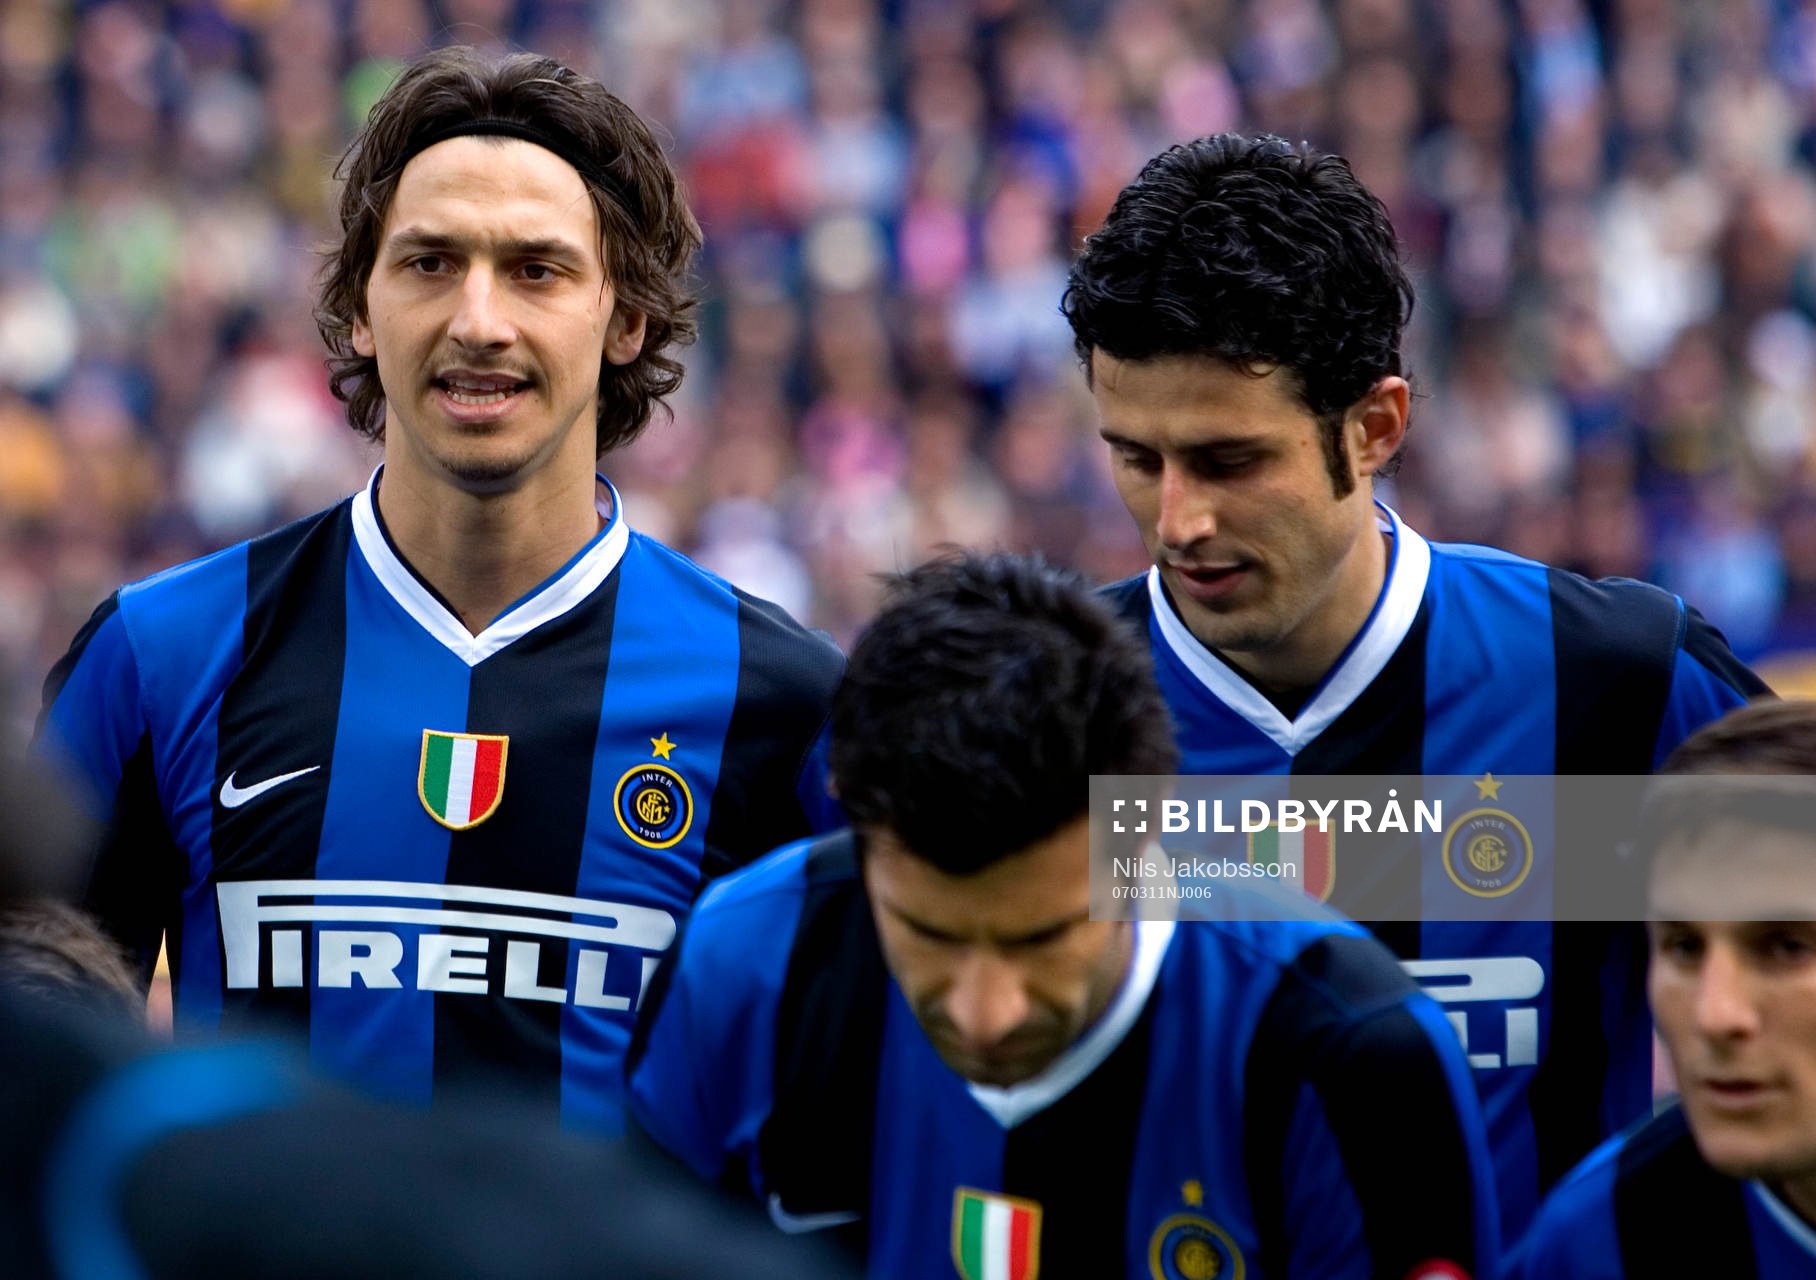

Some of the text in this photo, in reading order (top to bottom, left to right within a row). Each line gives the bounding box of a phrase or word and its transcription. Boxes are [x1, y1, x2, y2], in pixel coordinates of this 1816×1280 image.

[641, 773, 673, 788] INTER
[1470, 818, 1506, 831] INTER
[639, 826, 662, 839] 1908
